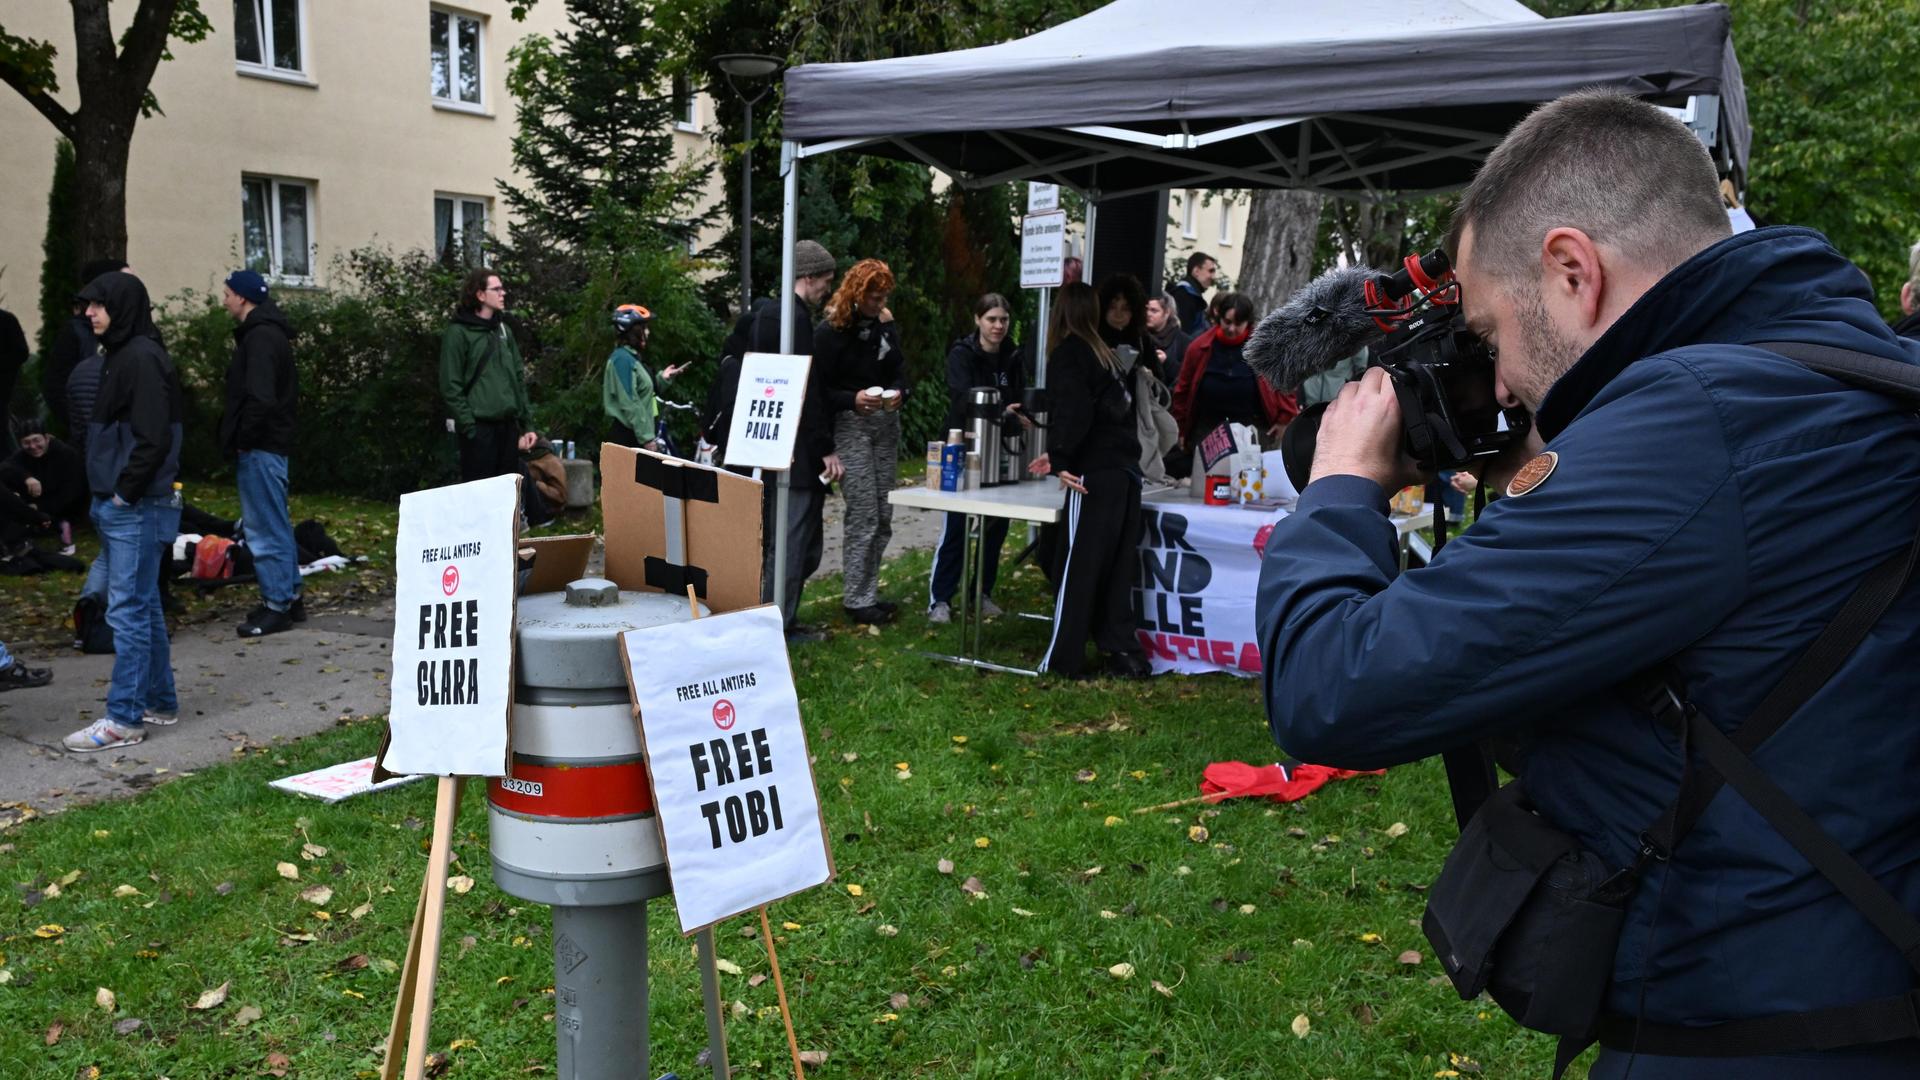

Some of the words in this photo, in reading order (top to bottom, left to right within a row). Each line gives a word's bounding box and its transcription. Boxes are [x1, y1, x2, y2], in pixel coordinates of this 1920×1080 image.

[749, 400, 784, 419] FREE
[745, 421, 779, 440] PAULA
[422, 548, 438, 563] FREE
[439, 546, 452, 561] ALL
[453, 541, 481, 559] ANTIFAS
[418, 600, 478, 650] FREE
[417, 658, 479, 706] CLARA
[676, 684, 701, 702] FREE
[702, 680, 719, 698] ALL
[721, 672, 756, 693] ANTIFAS
[689, 727, 773, 792] FREE
[503, 777, 541, 794] 33209
[700, 784, 784, 850] TOBI
